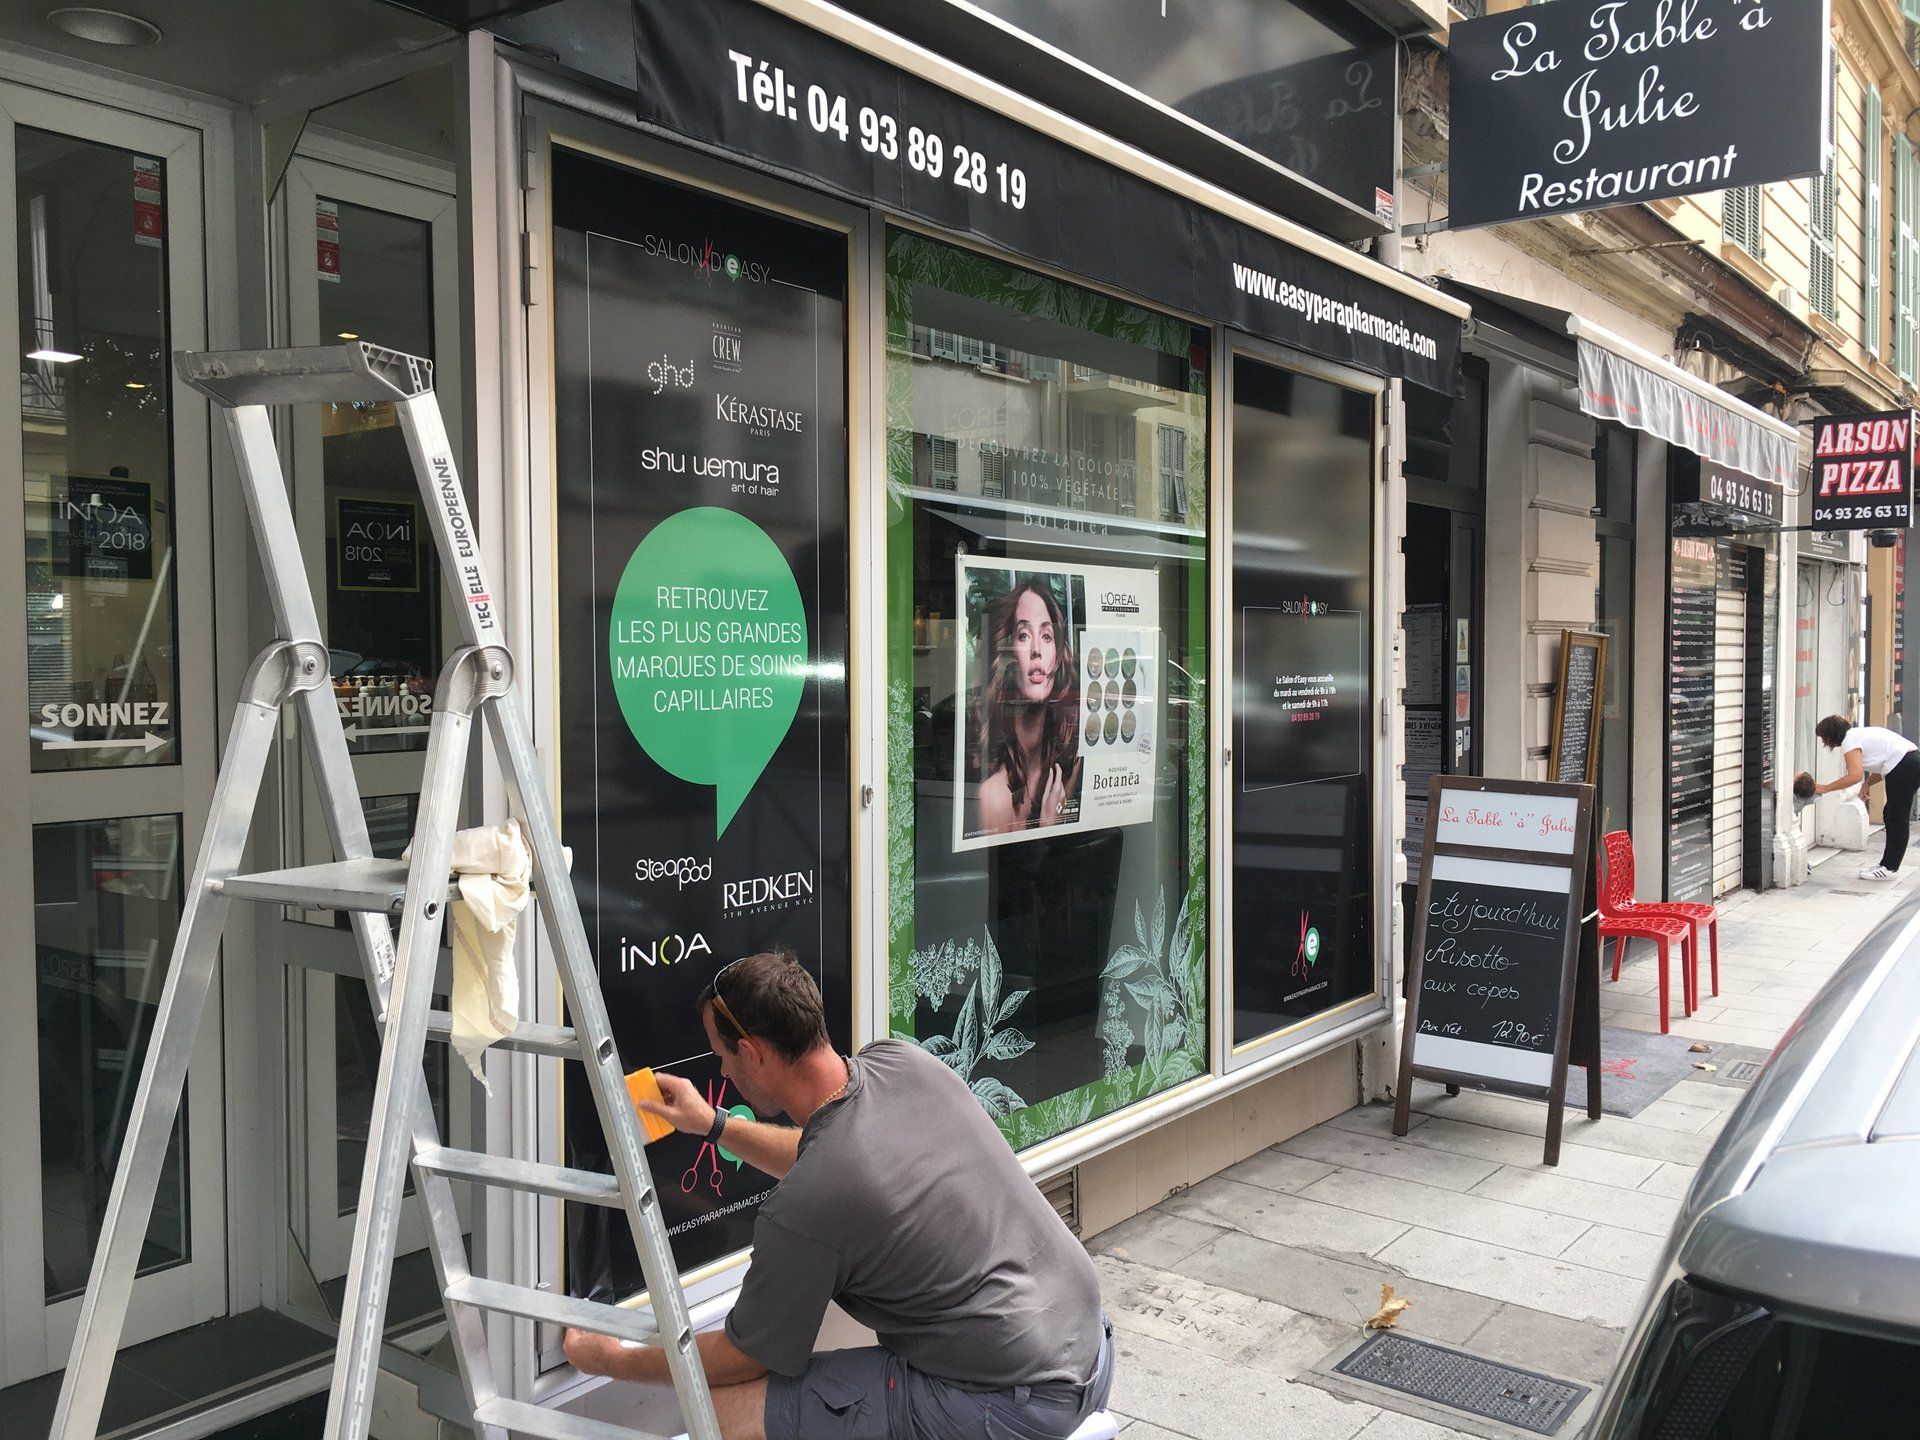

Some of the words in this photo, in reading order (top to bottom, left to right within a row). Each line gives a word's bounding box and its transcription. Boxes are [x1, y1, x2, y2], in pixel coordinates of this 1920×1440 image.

[1490, 21, 1562, 82] La
[1583, 0, 1718, 62] Table
[728, 48, 798, 121] Tél:
[807, 84, 849, 142] 04
[859, 106, 899, 161] 93
[908, 126, 944, 178] 89
[952, 144, 988, 194] 28
[996, 162, 1027, 210] 19
[1553, 65, 1700, 165] Julie
[1518, 144, 1738, 212] Restaurant
[645, 234, 703, 267] SALON
[1232, 262, 1437, 361] www.easyparapharmacie.com
[712, 334, 741, 363] CREW
[647, 353, 695, 395] ghd
[716, 393, 803, 433] KÉRASTASE
[750, 428, 771, 438] PARIS
[1816, 419, 1909, 457] ARSON
[641, 446, 686, 474] shu
[693, 455, 780, 484] uemura
[1819, 459, 1903, 497] PIZZA
[731, 483, 746, 493] art
[748, 485, 758, 494] of
[760, 486, 780, 496] hair
[1710, 474, 1723, 501] 04
[1725, 480, 1737, 505] 93
[1739, 484, 1750, 509] 26
[1752, 489, 1762, 513] 63
[1764, 492, 1773, 516] 13
[1815, 508, 1833, 521] 04
[1835, 507, 1852, 520] 93
[1854, 506, 1871, 519] 26
[1874, 505, 1892, 518] 63
[1895, 504, 1907, 517] 13
[98, 531, 146, 550] 2018
[657, 586, 769, 611] RETROUVEZ
[618, 620, 655, 643] LES
[661, 621, 712, 643] PLUS
[717, 622, 802, 644] GRANDES
[617, 655, 716, 679] MARQUES
[722, 655, 746, 676] DE
[750, 654, 803, 676] SOINS
[41, 702, 169, 729] SONNEZ
[653, 687, 774, 712] CAPILLAIRES
[1440, 806, 1460, 823] La
[1466, 808, 1504, 827] Table
[1538, 815, 1576, 837] Julie
[723, 869, 814, 909] REDKEN
[749, 902, 789, 915] AVENUE
[795, 897, 814, 906] NYC
[1425, 938, 1520, 971] Risotto
[1424, 979, 1456, 993] aux
